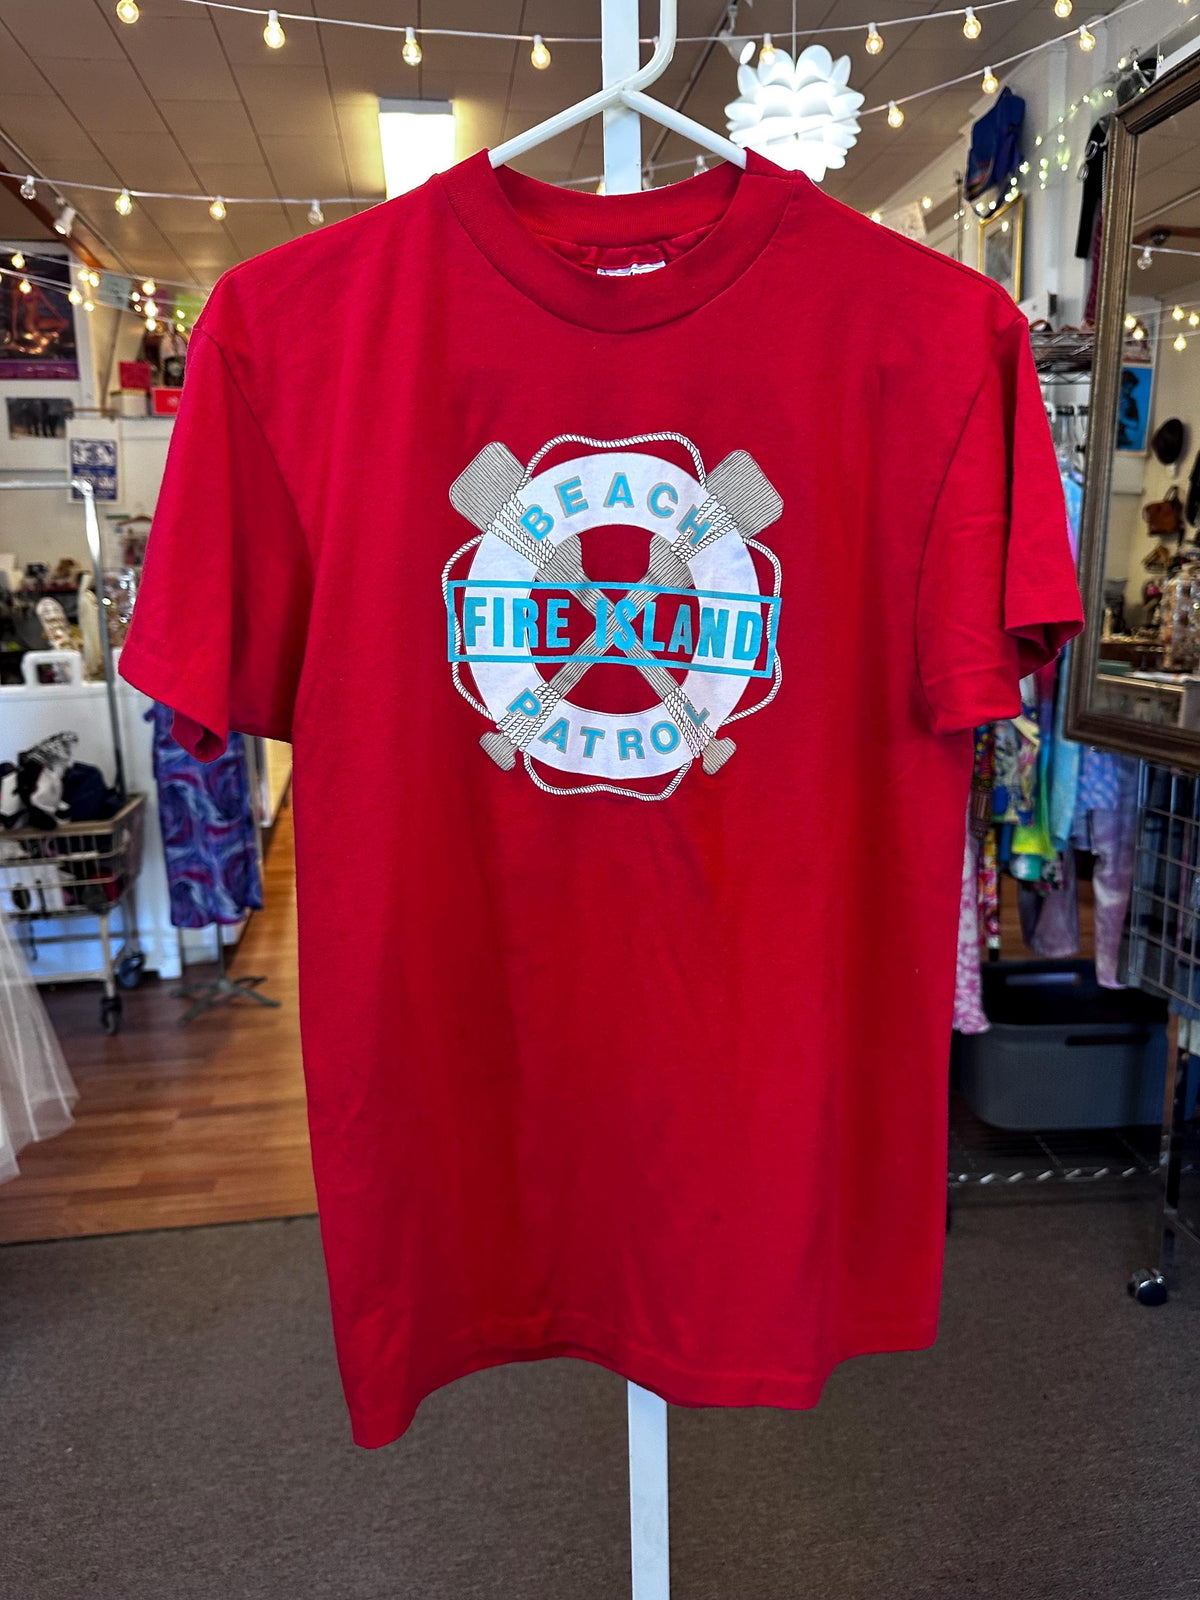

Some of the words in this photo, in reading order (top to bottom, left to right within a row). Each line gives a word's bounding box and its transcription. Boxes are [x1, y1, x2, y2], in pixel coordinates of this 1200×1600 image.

[520, 472, 711, 545] BEACH
[463, 597, 571, 648] FIRE
[595, 598, 763, 661] ISLAND
[506, 687, 710, 760] PATROL
